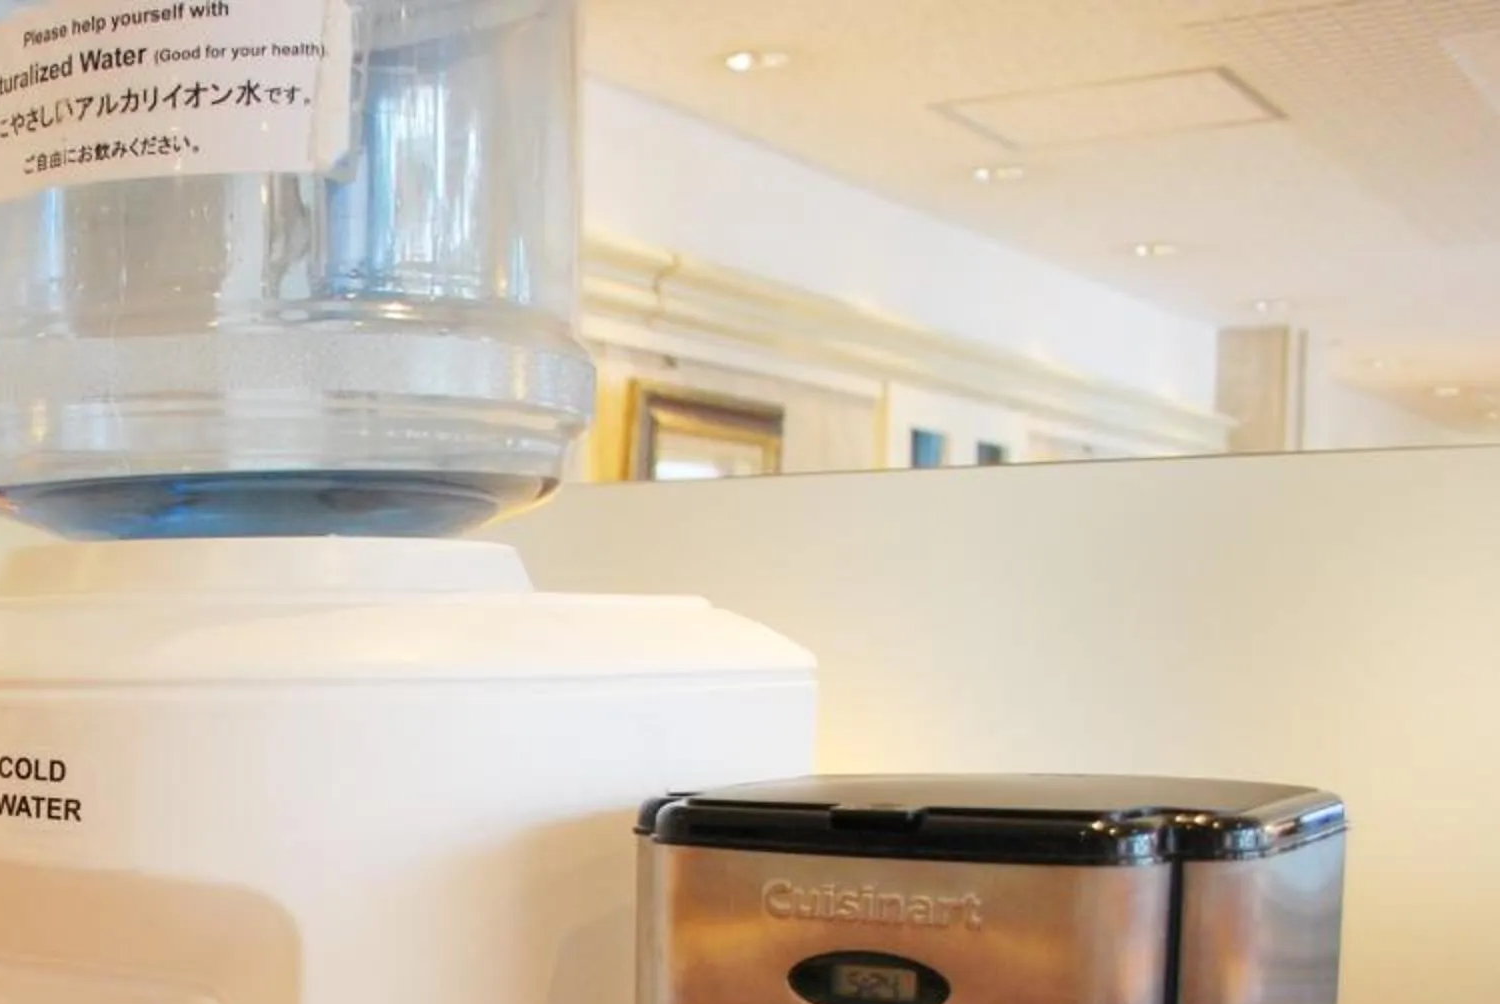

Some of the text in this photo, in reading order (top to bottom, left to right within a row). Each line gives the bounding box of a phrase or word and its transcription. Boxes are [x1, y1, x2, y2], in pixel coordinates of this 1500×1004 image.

[23, 1, 229, 48] Please help yourself with
[79, 48, 147, 74] Water
[154, 46, 200, 64] (Good
[205, 45, 225, 59] for
[231, 46, 267, 61] your
[762, 878, 982, 931] Cuisinart
